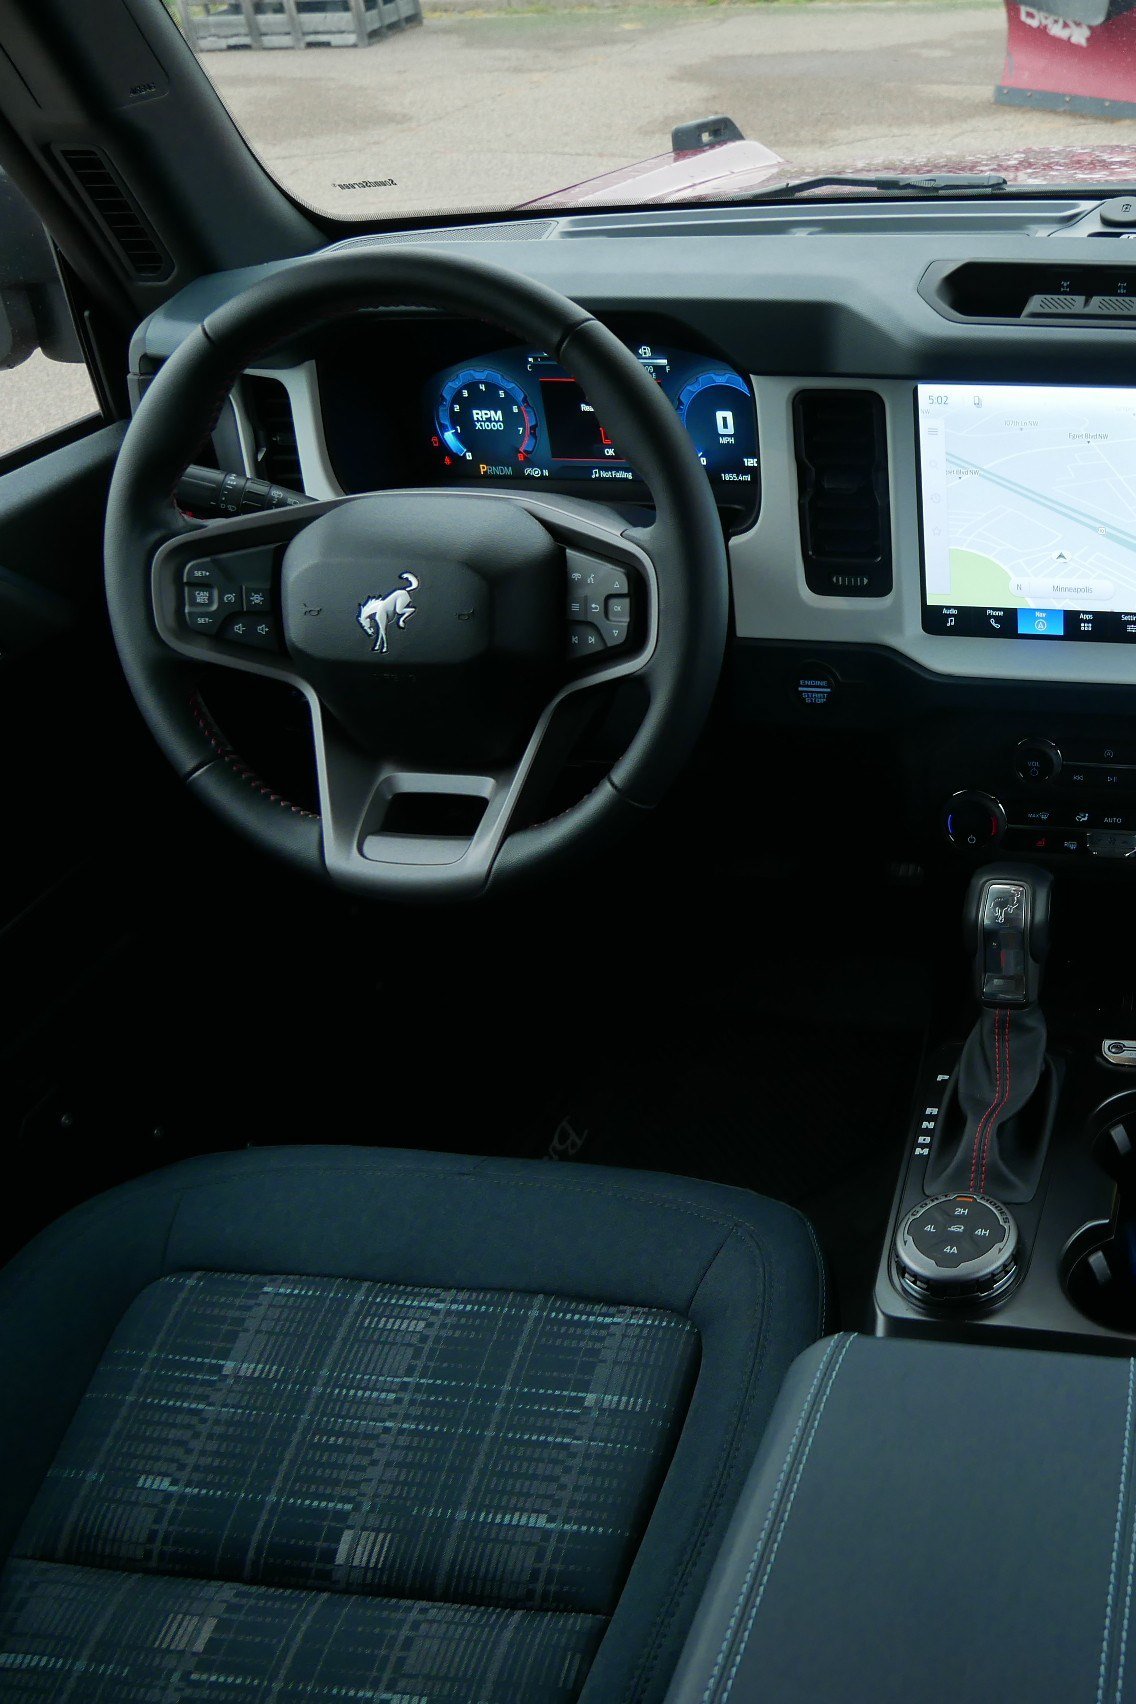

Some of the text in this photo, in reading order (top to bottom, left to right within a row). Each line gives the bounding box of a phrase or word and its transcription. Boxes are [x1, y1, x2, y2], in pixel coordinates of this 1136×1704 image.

[479, 384, 486, 392] 4
[928, 395, 949, 406] 5:02
[512, 405, 519, 413] 6
[472, 409, 503, 422] RPM
[475, 422, 504, 431] X1000
[715, 410, 735, 435] 0
[518, 427, 523, 435] 7
[465, 452, 473, 460] 0
[604, 448, 615, 457] OK
[700, 457, 707, 465] 0
[600, 470, 633, 480] Not Falling
[1016, 583, 1022, 591] N
[1052, 584, 1093, 595] Minneapolis
[942, 607, 958, 615] Audio
[1079, 613, 1093, 622] Apps
[1028, 760, 1040, 768] VOL
[925, 1107, 938, 1115] R
[921, 1121, 935, 1129] N
[914, 1147, 929, 1155] M
[954, 1207, 969, 1216] 2H
[923, 1224, 936, 1232] 4L
[974, 1228, 990, 1237] 4H
[943, 1245, 958, 1254] 4A
